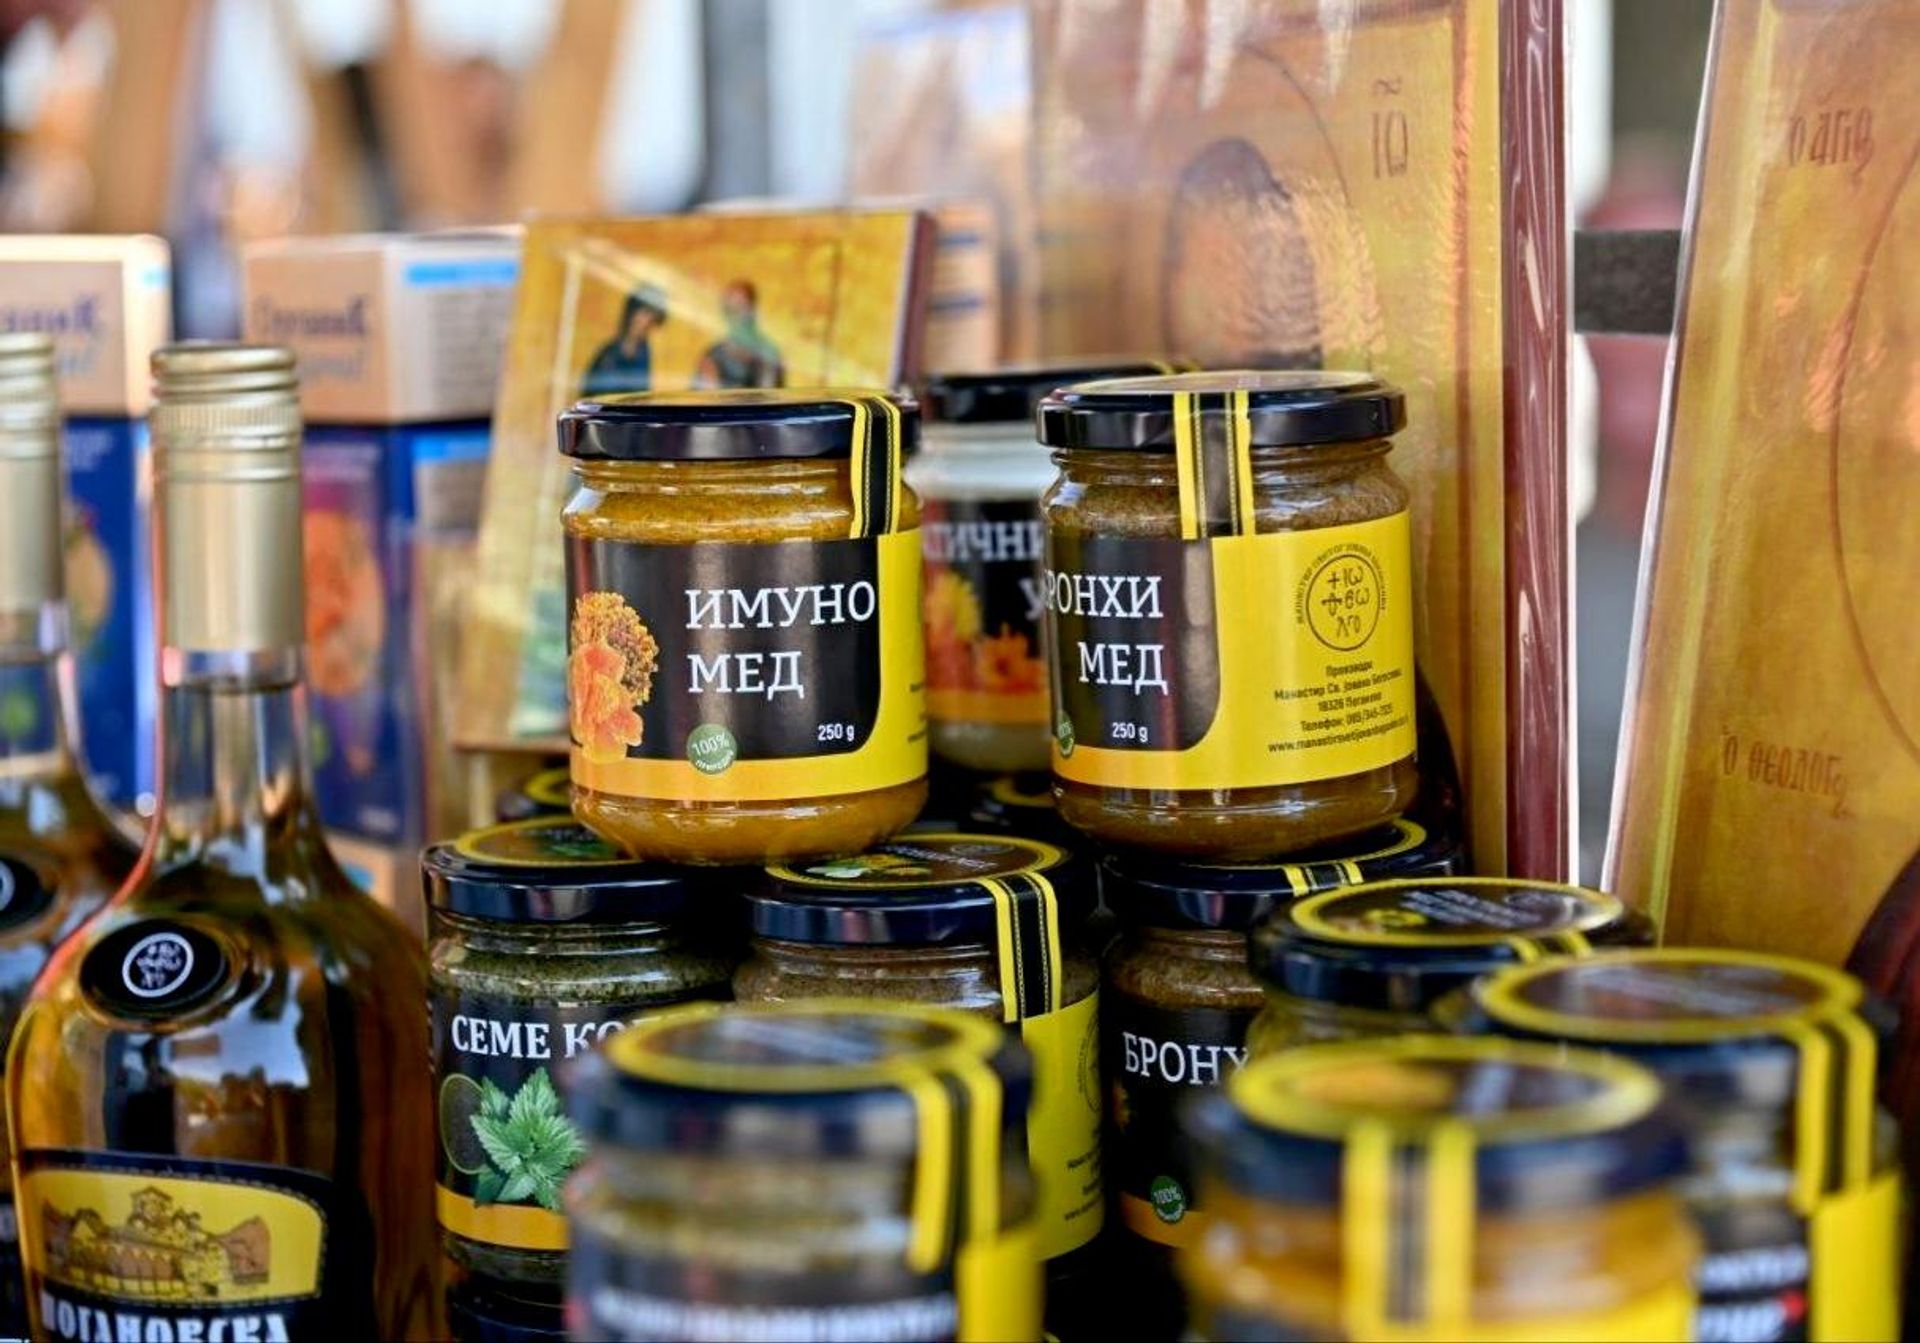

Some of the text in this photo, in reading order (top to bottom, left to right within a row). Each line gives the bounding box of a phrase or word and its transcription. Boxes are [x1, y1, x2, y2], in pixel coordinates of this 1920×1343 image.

[684, 581, 876, 629] ИМУНО
[1044, 569, 1164, 618] РОНХИ
[686, 651, 805, 701] МЕД
[1077, 641, 1169, 696] МЕД
[692, 731, 730, 757] 100%
[818, 723, 855, 741] 250 g
[1112, 722, 1148, 743] 250 g
[451, 1014, 551, 1059] СЕМЕ
